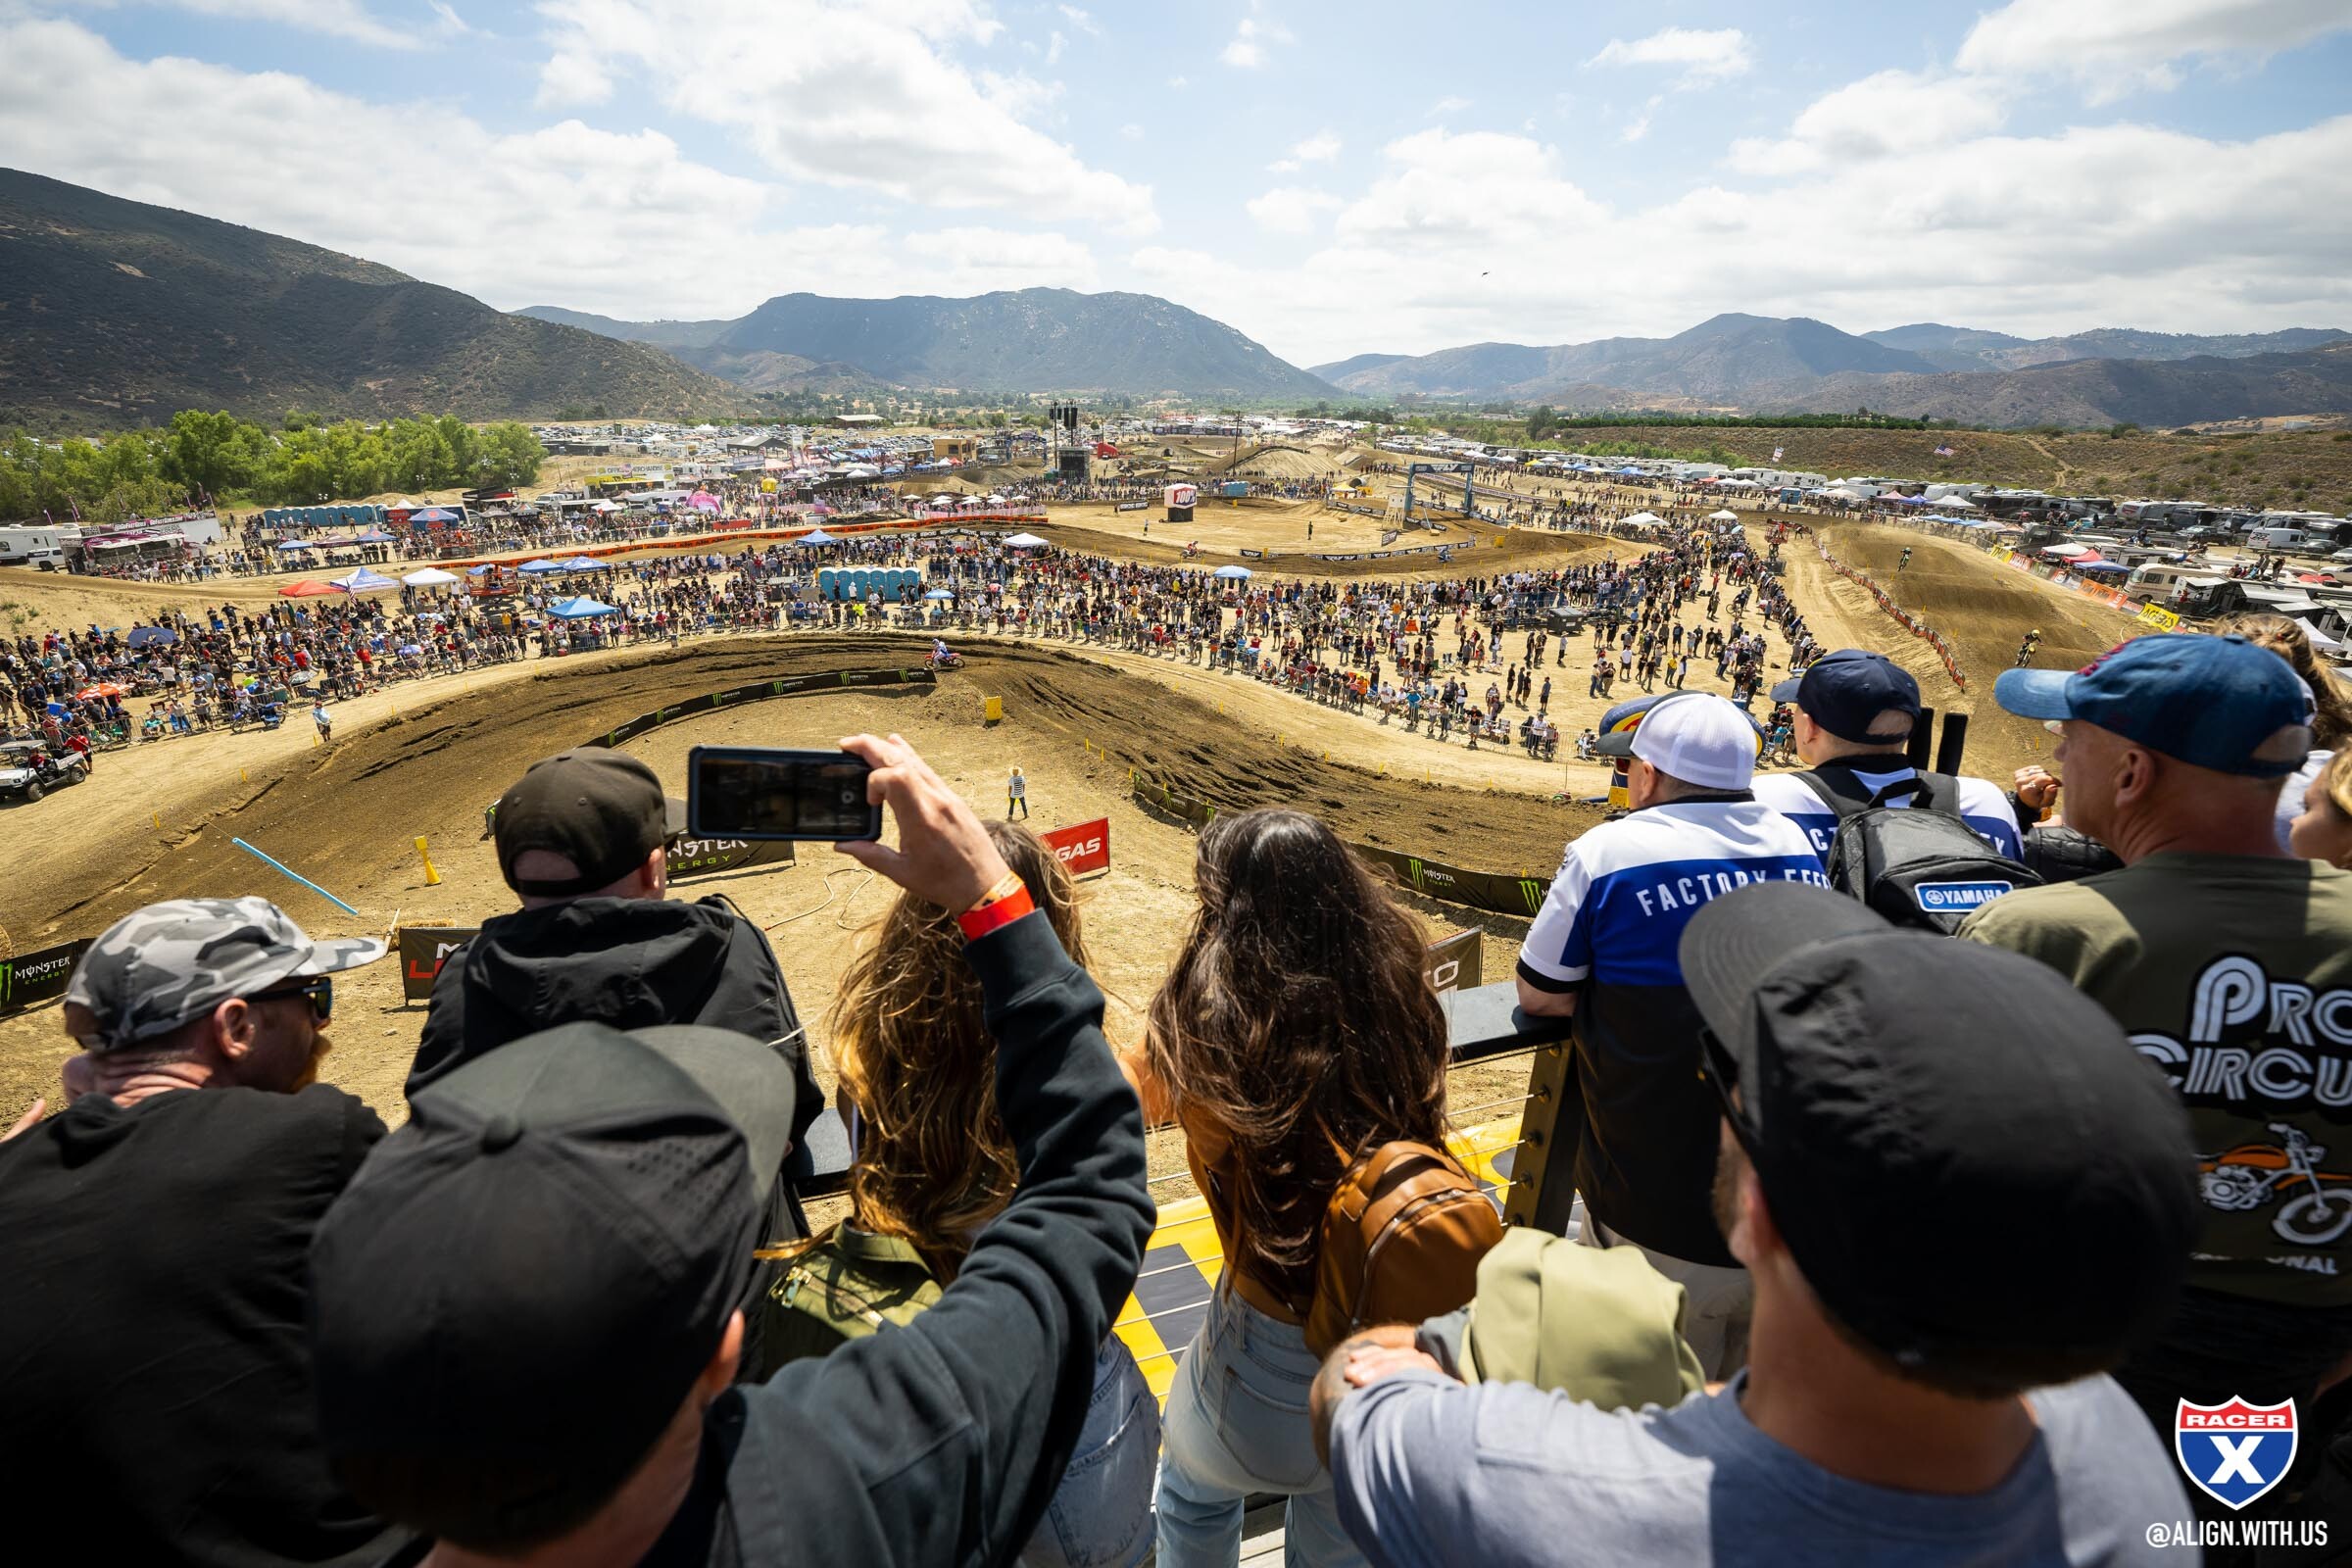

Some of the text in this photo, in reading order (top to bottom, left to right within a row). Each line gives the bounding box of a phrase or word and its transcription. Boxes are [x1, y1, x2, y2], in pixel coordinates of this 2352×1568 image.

[1175, 489, 1196, 504] 100%
[2141, 608, 2175, 629] ACERBIS
[666, 839, 749, 858] NSTER
[1054, 837, 1102, 862] GAS
[666, 855, 730, 871] NERGY
[1423, 868, 1455, 884] MONSTER
[15, 956, 71, 980] MONSTER
[24, 970, 66, 985] ENERGY
